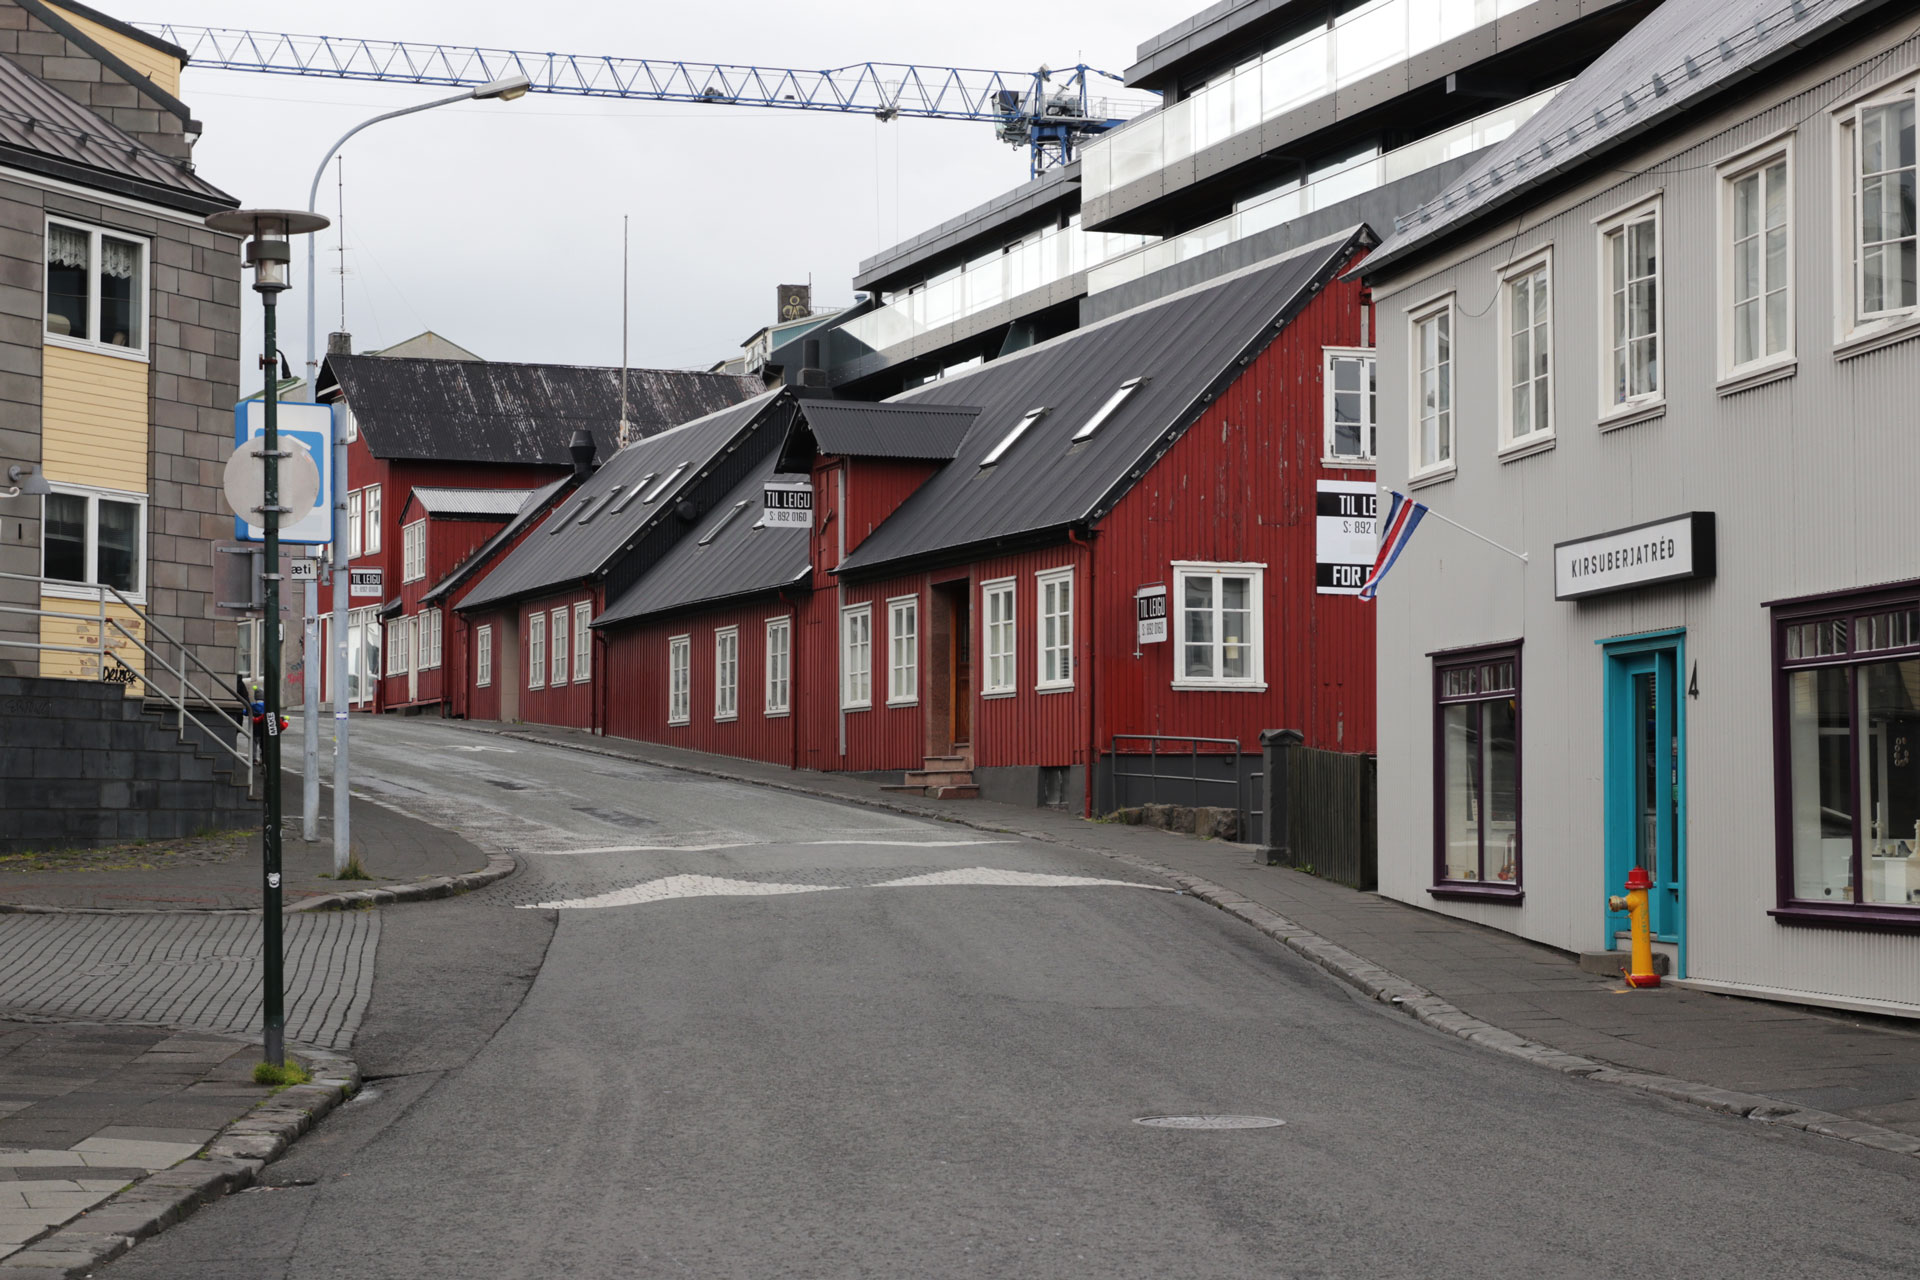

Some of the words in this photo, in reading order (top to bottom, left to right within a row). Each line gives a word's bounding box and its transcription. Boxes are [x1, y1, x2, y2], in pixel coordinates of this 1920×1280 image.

[766, 491, 780, 507] TIL
[783, 492, 810, 508] LEIGU
[1338, 494, 1358, 515] TIL
[769, 511, 776, 521] S:
[777, 511, 790, 521] 892
[791, 512, 807, 522] 0160
[1343, 520, 1352, 534] S:
[1354, 521, 1371, 535] 892
[352, 574, 361, 585] TIL
[363, 574, 381, 585] LEIGU
[1332, 565, 1361, 587] FOR
[1688, 658, 1700, 700] 4
